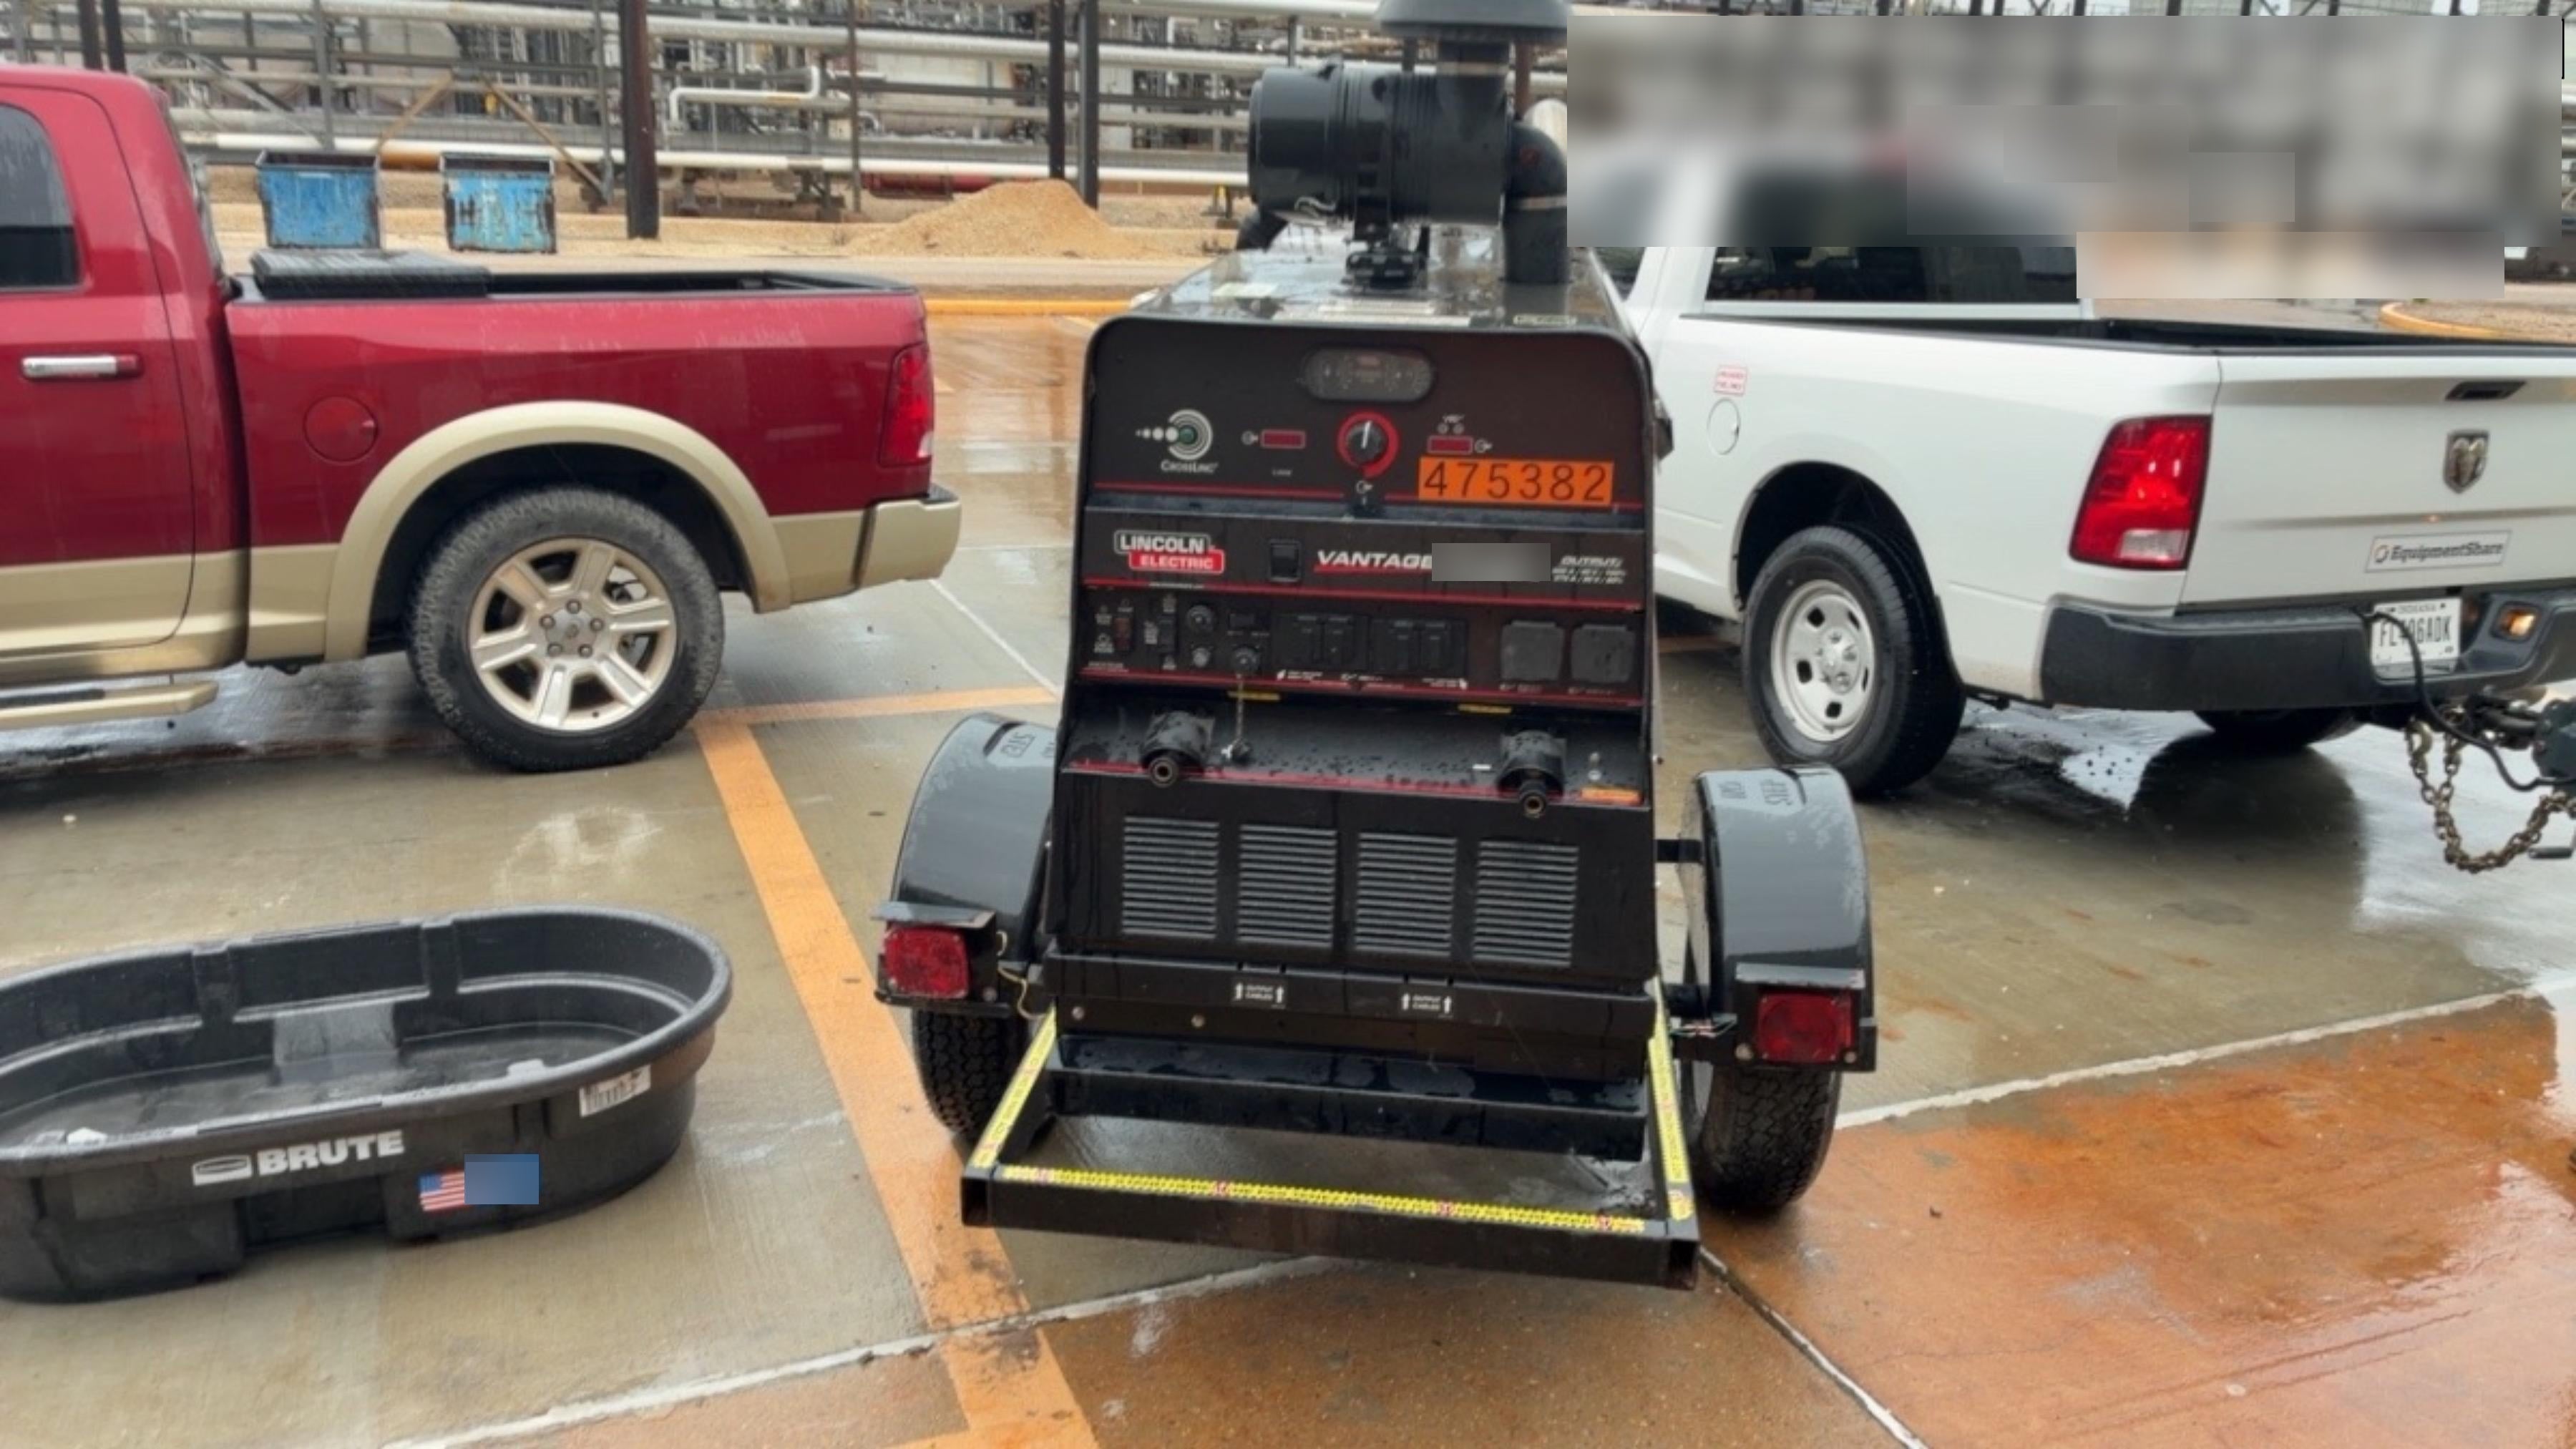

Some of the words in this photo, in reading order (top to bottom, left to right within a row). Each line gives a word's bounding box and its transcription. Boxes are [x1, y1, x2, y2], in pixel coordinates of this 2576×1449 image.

[1424, 461, 1606, 502] 475382
[1120, 535, 1205, 554] LINCOLN
[2391, 542, 2503, 562] EquipmentShare
[1139, 555, 1214, 570] ELECTRIC
[256, 1130, 405, 1176] BRUTE
